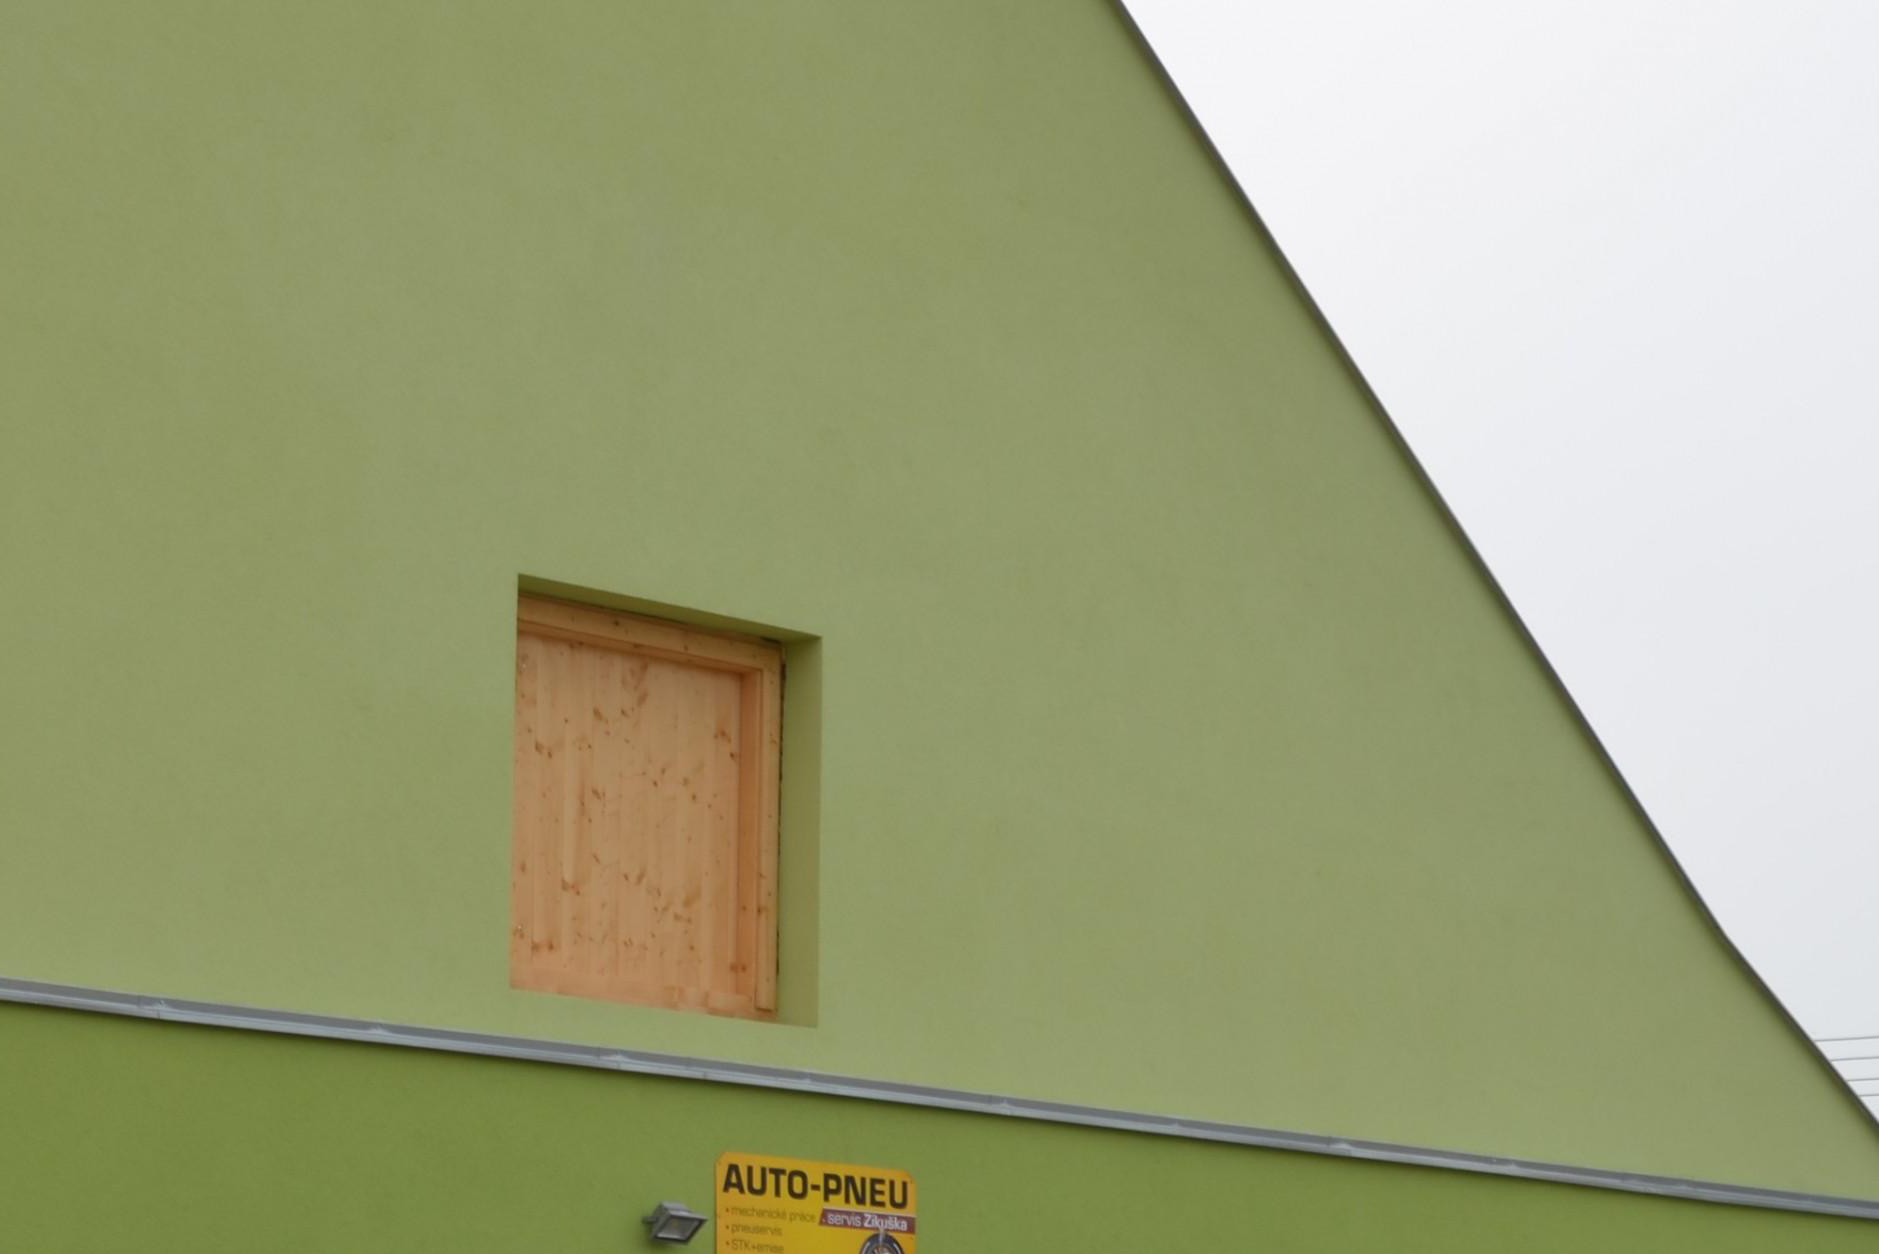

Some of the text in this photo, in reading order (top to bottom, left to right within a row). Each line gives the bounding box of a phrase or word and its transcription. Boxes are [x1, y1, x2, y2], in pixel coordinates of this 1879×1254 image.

[723, 1163, 908, 1209] AUTO-PNEU
[827, 1213, 908, 1231] servis Zikuška
